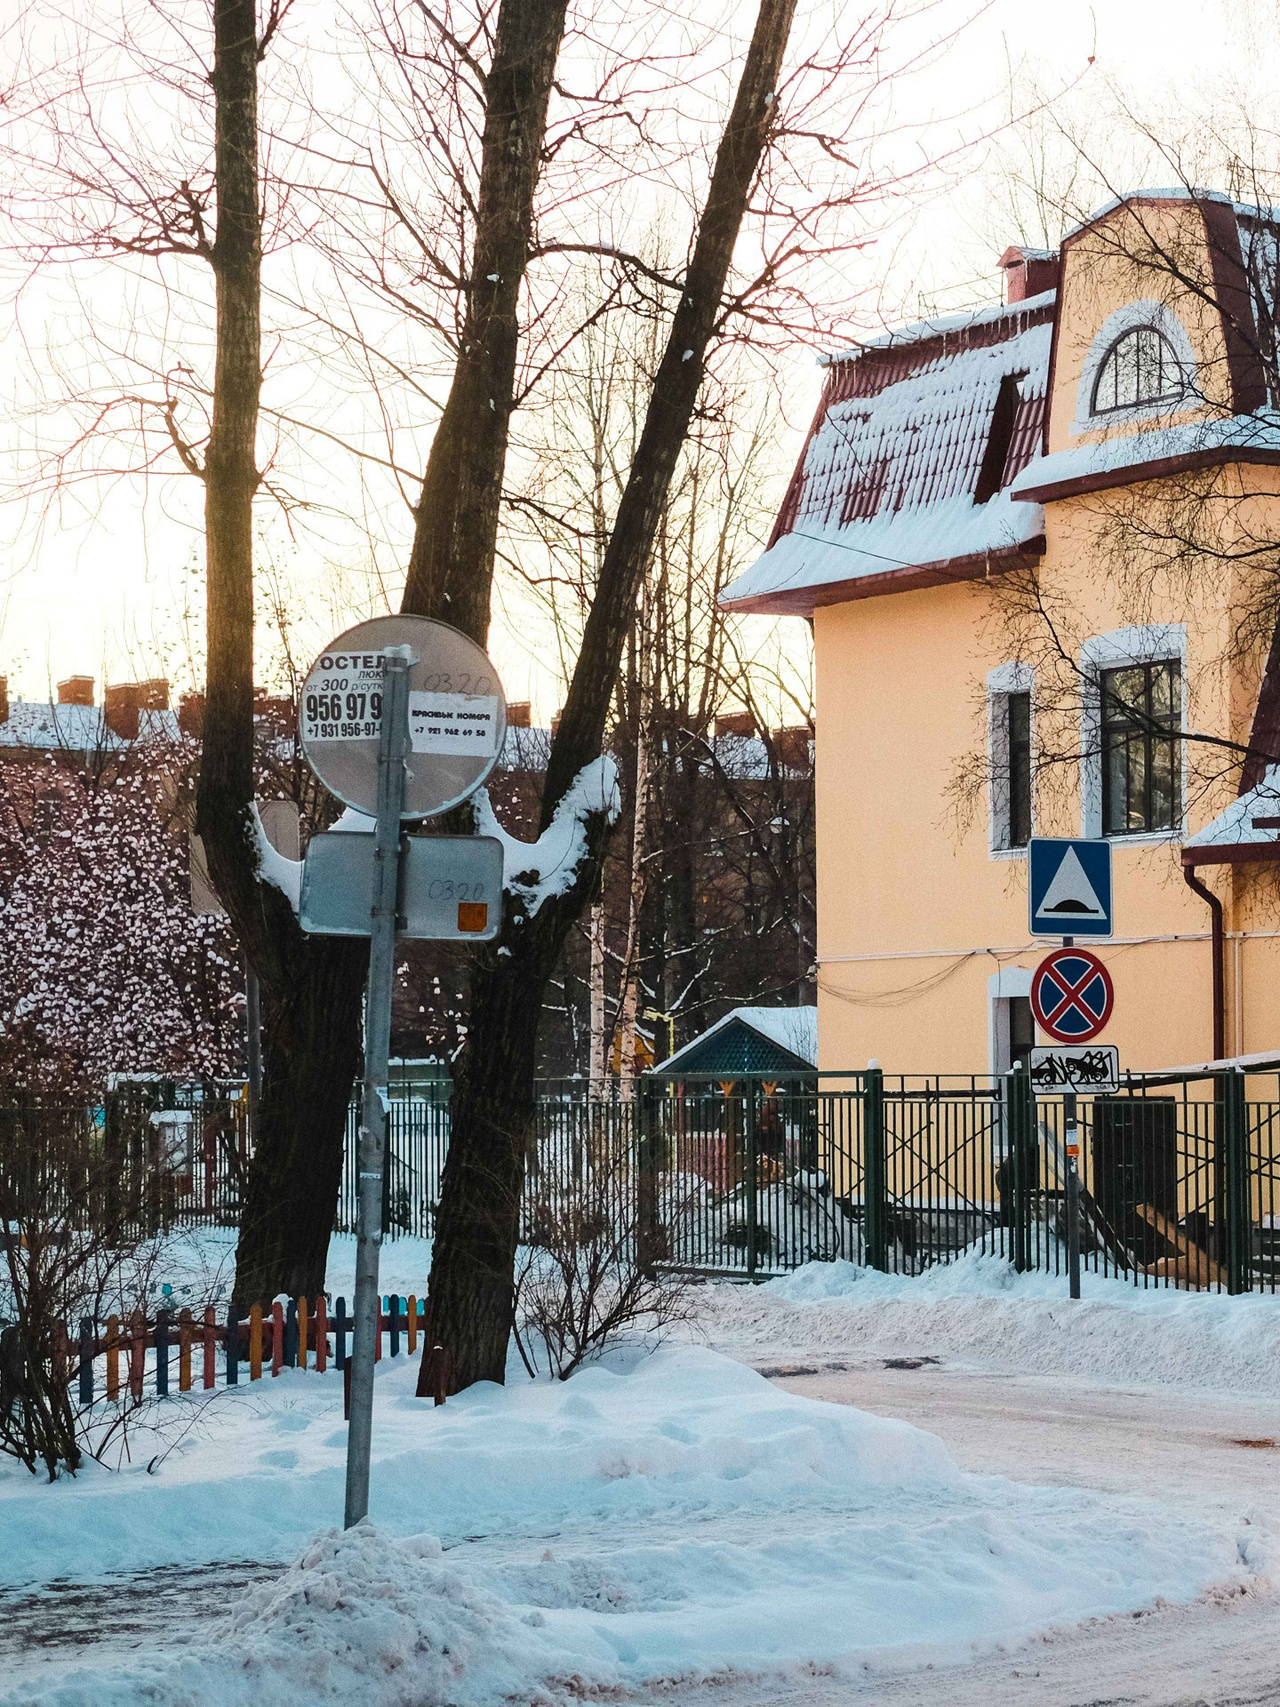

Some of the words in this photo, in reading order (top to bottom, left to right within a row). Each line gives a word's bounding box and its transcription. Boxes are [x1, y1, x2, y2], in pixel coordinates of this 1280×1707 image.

[358, 670, 385, 679] ЛЮК
[321, 679, 348, 692] 300
[424, 673, 491, 696] 0320
[306, 694, 342, 722] 956
[346, 693, 366, 720] 97
[457, 712, 490, 721] НОМЕРА
[307, 724, 319, 738] +7
[321, 723, 338, 737] 931
[341, 722, 383, 737] 956-97-
[428, 727, 441, 735] 921
